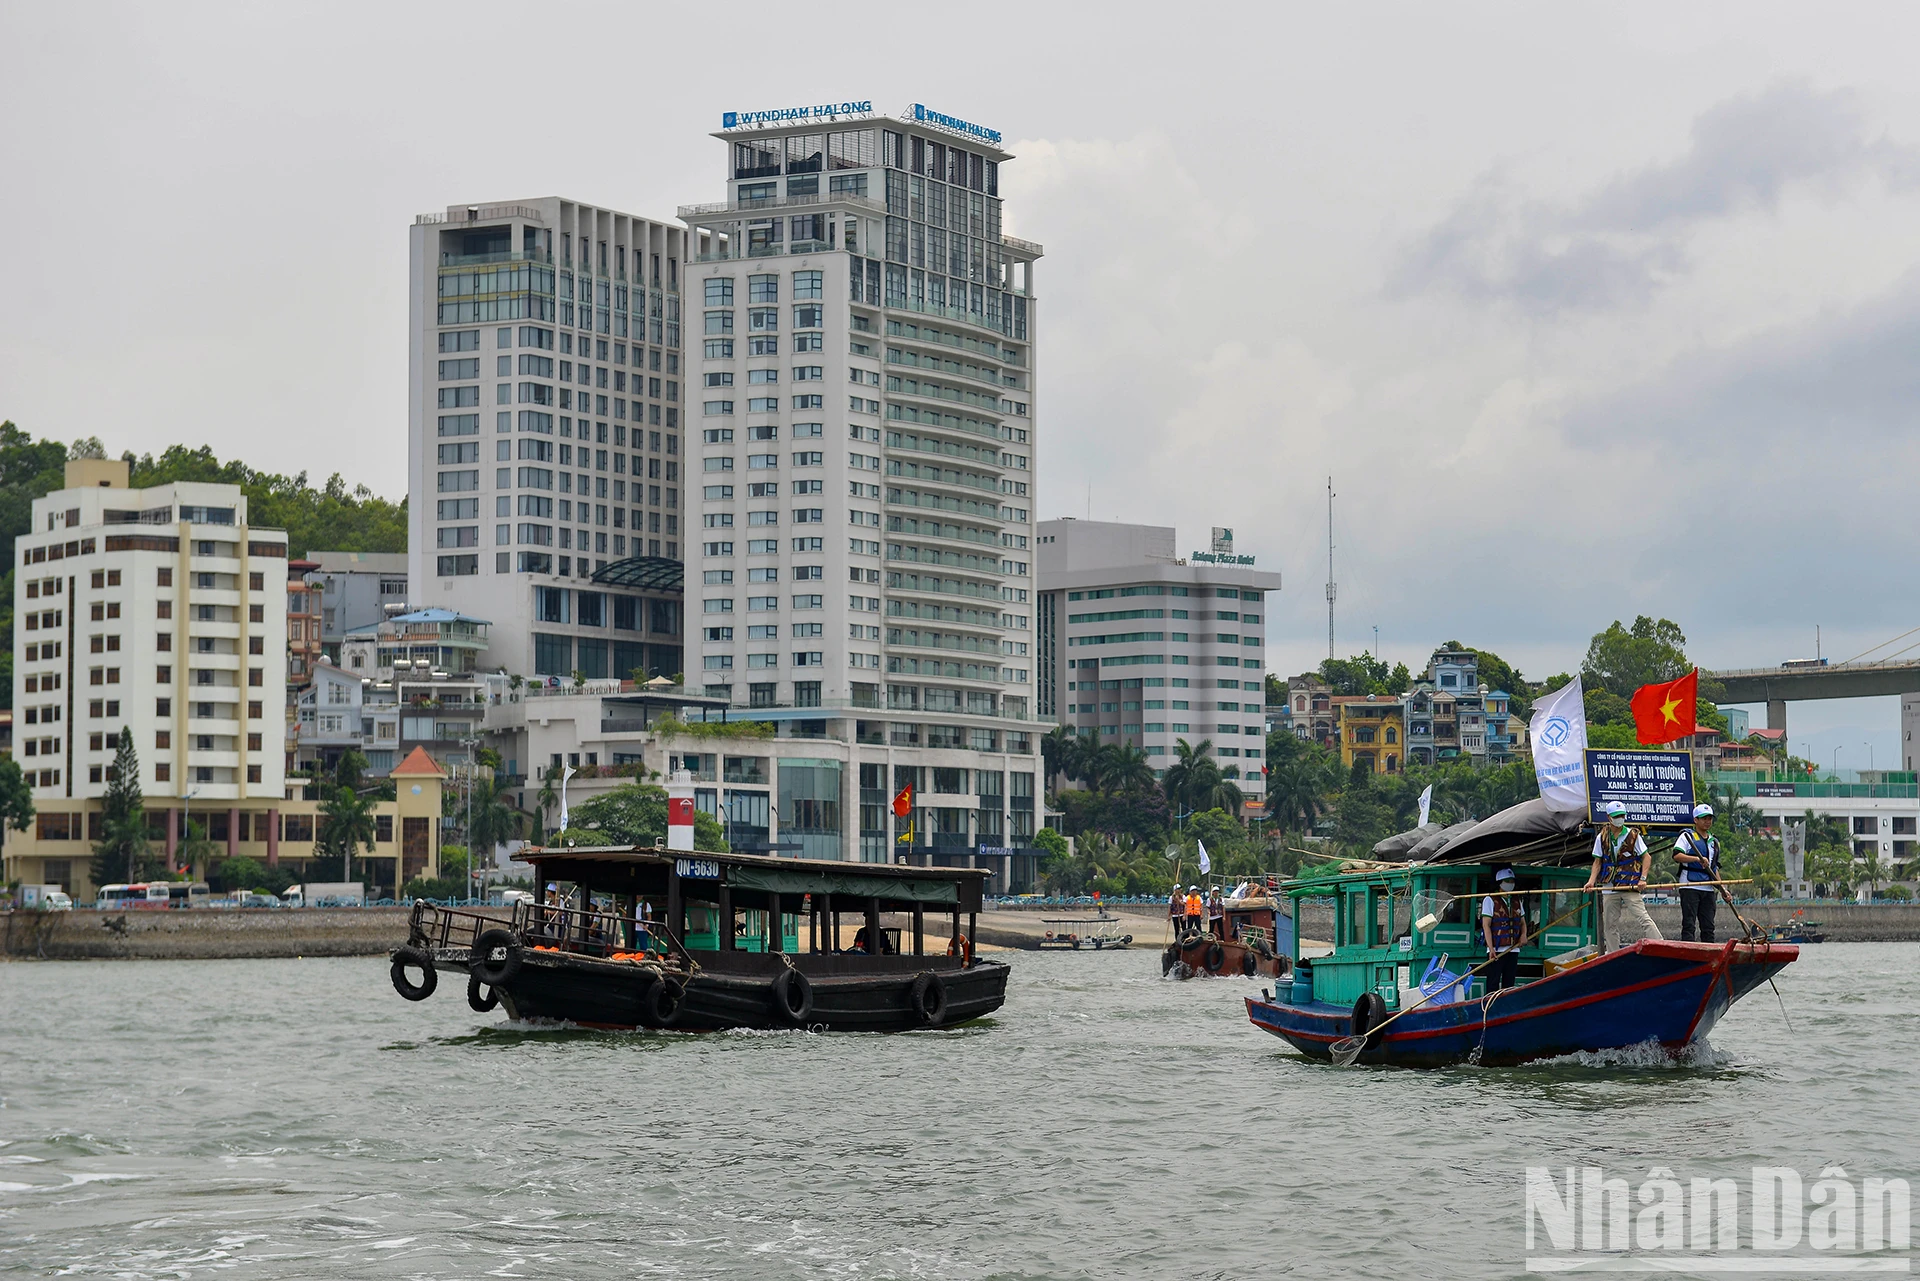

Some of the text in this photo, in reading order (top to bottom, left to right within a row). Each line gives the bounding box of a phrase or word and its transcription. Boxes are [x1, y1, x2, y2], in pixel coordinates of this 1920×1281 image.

[741, 100, 872, 123] WYNDHAM HALONG
[926, 109, 1002, 142] WYNDHAM HALONG
[1593, 762, 1608, 778] TÀU
[1610, 761, 1625, 779] BẢO
[1626, 763, 1637, 781] VỆ
[1639, 763, 1654, 779] MÔI
[1655, 764, 1686, 780] TRƯỜNG
[1607, 781, 1627, 790] XANH
[1634, 781, 1654, 791] SẠCH
[1659, 783, 1674, 792] ĐẸP
[1656, 804, 1689, 814] PROTECTION
[676, 858, 719, 877] QN-5630
